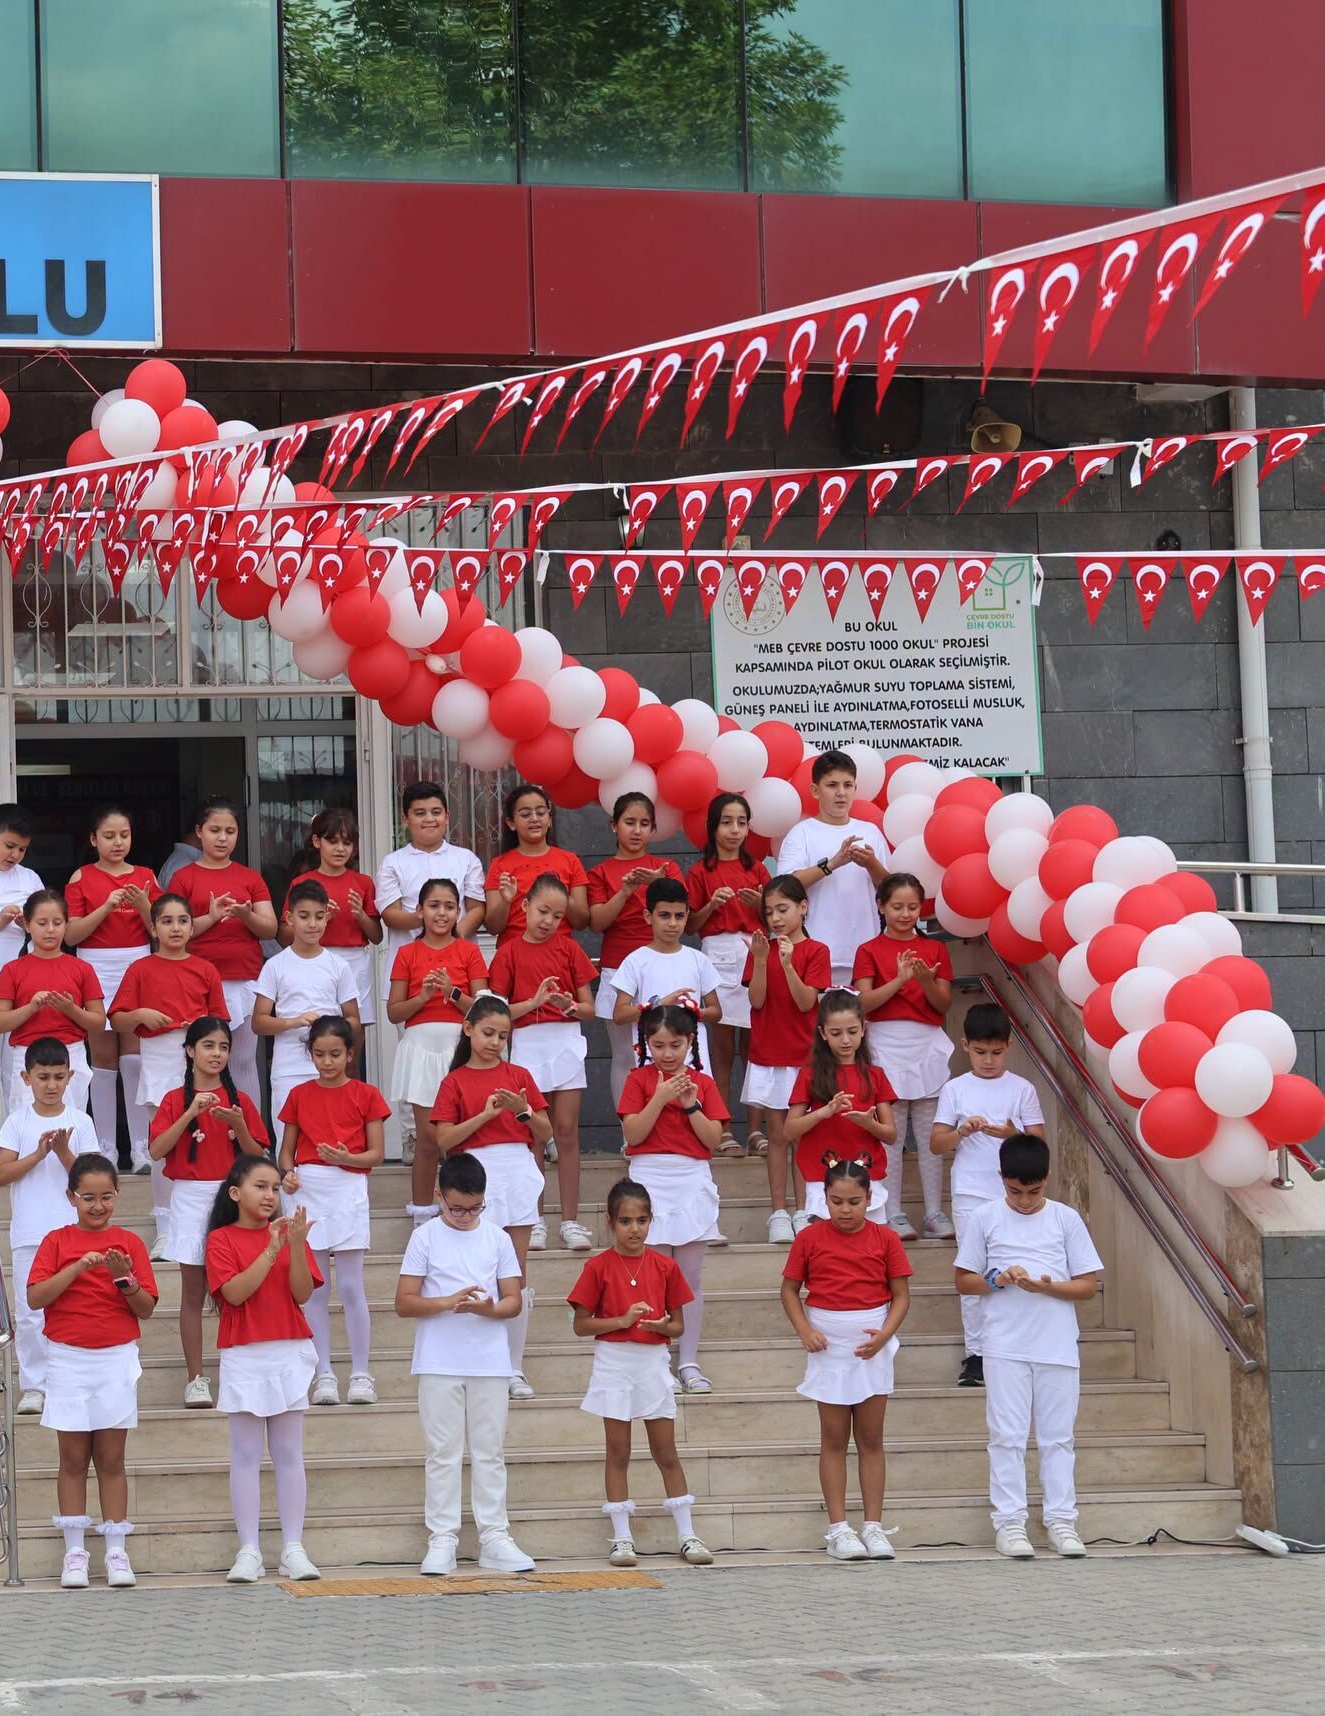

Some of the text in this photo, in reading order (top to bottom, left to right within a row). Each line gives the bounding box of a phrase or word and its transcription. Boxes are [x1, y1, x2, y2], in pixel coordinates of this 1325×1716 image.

[844, 621, 898, 632] BU OKUL
[987, 620, 1016, 629] OKUL
[753, 634, 989, 655] "MEB ÇEVRE DOSTU 1000 OKUL" PROJESİ
[735, 653, 1011, 673] KAPSAMINDA PİLOT OKUL OLARAK SEÇİLMİŞTİR.
[874, 681, 906, 693] SUYU
[909, 679, 965, 692] TOPLAMA
[968, 675, 1016, 690] SİSTEMİ,
[724, 702, 766, 717] GÜNEŞ
[769, 700, 810, 714] PANELİ
[813, 700, 830, 713] İLE
[973, 697, 1026, 709] MUSLUK,
[950, 717, 984, 728] VANA
[924, 755, 1010, 769] MİZ KALACAK"
